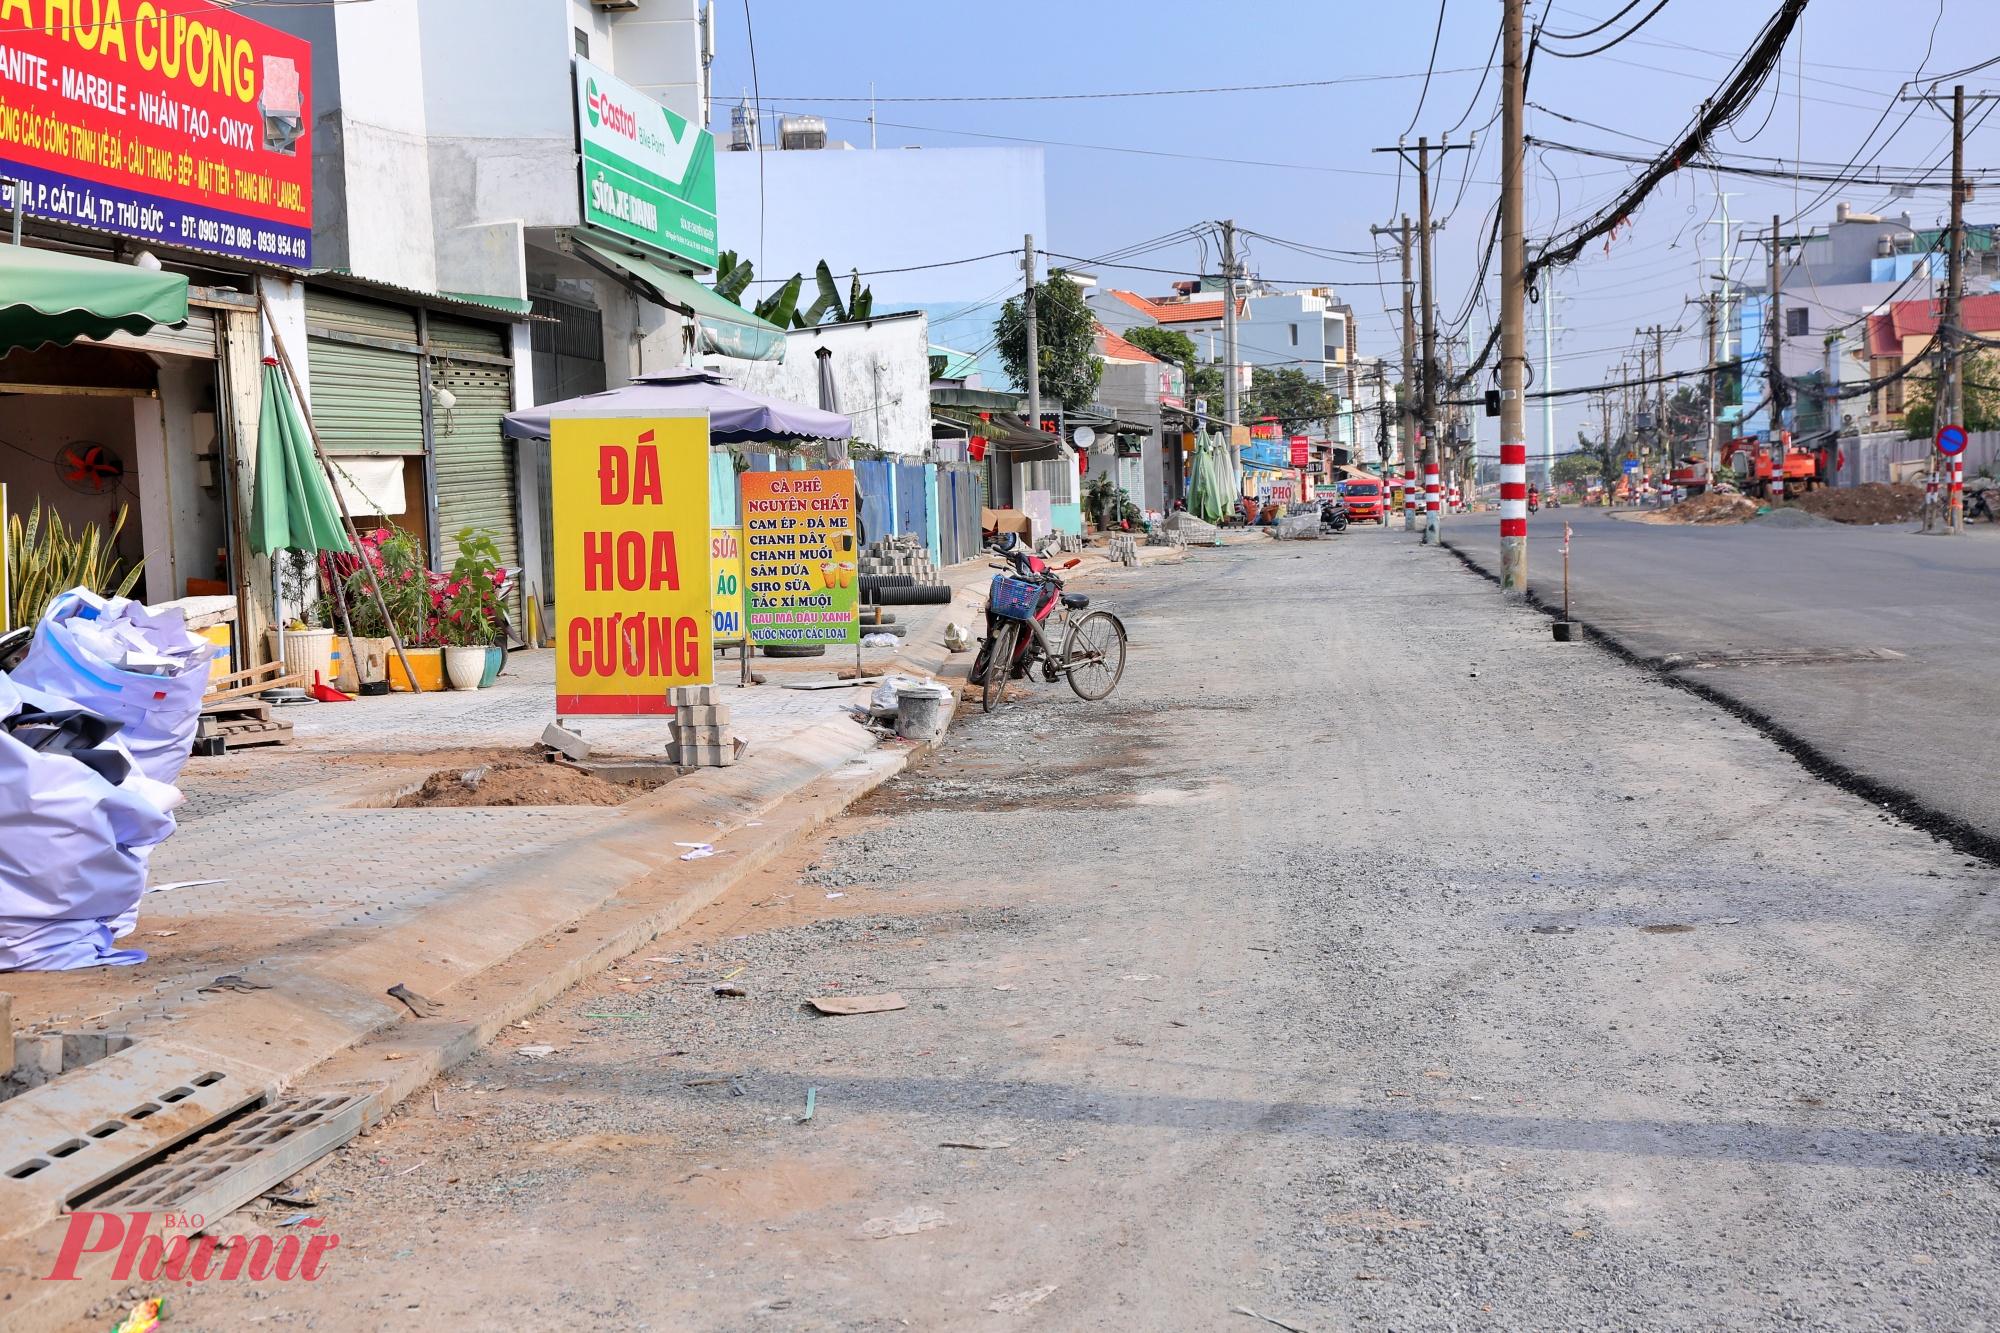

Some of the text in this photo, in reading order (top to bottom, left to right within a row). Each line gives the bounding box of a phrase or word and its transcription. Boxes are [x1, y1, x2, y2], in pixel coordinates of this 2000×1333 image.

[135, 2, 254, 103] CƯƠNG
[62, 65, 126, 116] MARBLE
[139, 90, 178, 131] NHÂN
[182, 104, 209, 142] TẠO
[220, 116, 254, 152] ONYX
[600, 92, 666, 157] Castrol Bike Point
[22, 104, 42, 149] CÁC
[44, 110, 69, 156] CÔNG
[71, 119, 96, 164] TRÌNH
[110, 130, 122, 170] ĐÁ
[128, 136, 144, 176] CẦU
[146, 146, 172, 182] THANG
[178, 149, 192, 186] BẾP
[234, 168, 258, 202] THANG
[258, 168, 272, 205] MÁY
[591, 170, 658, 233] SỬA XE DANH
[38, 183, 48, 210] P.
[51, 184, 74, 215] CÁT
[76, 189, 97, 224] LÁI,
[100, 198, 115, 224] TP.
[118, 200, 139, 229] THỦ
[140, 204, 164, 233] ĐỨC
[182, 214, 196, 240] ĐT:
[198, 218, 218, 244] 0903
[220, 224, 235, 246] 729
[237, 226, 251, 250] 089
[258, 230, 276, 254] 0938
[278, 234, 291, 257] 954
[292, 237, 306, 260] 418
[598, 428, 663, 505] ĐÁ
[770, 478, 822, 493] CÀ PHÊ
[1272, 482, 1292, 499] PHỞ
[748, 494, 849, 512] NGUYÊN CHẤT
[749, 520, 777, 530] CAM
[780, 516, 796, 528] ÉP
[806, 516, 826, 528] ĐÁ
[829, 517, 848, 528] ME
[712, 530, 738, 558] SỬA
[750, 532, 826, 546] CHANH DÂY
[584, 531, 680, 592] HOA
[750, 545, 833, 561] CHANH MUỐI
[750, 562, 810, 576] SÂM DỨA
[716, 569, 738, 596] ÁO
[751, 578, 812, 592] SIRO SỮA
[751, 592, 832, 609] TẮC XÍ MUỘI
[714, 612, 738, 636] OẠI
[751, 611, 852, 625] RAU MÁ ĐẬU XANH
[568, 612, 698, 677] CƯƠNG
[752, 626, 847, 642] NƯỚC NGỌT CÁC LOẠI
